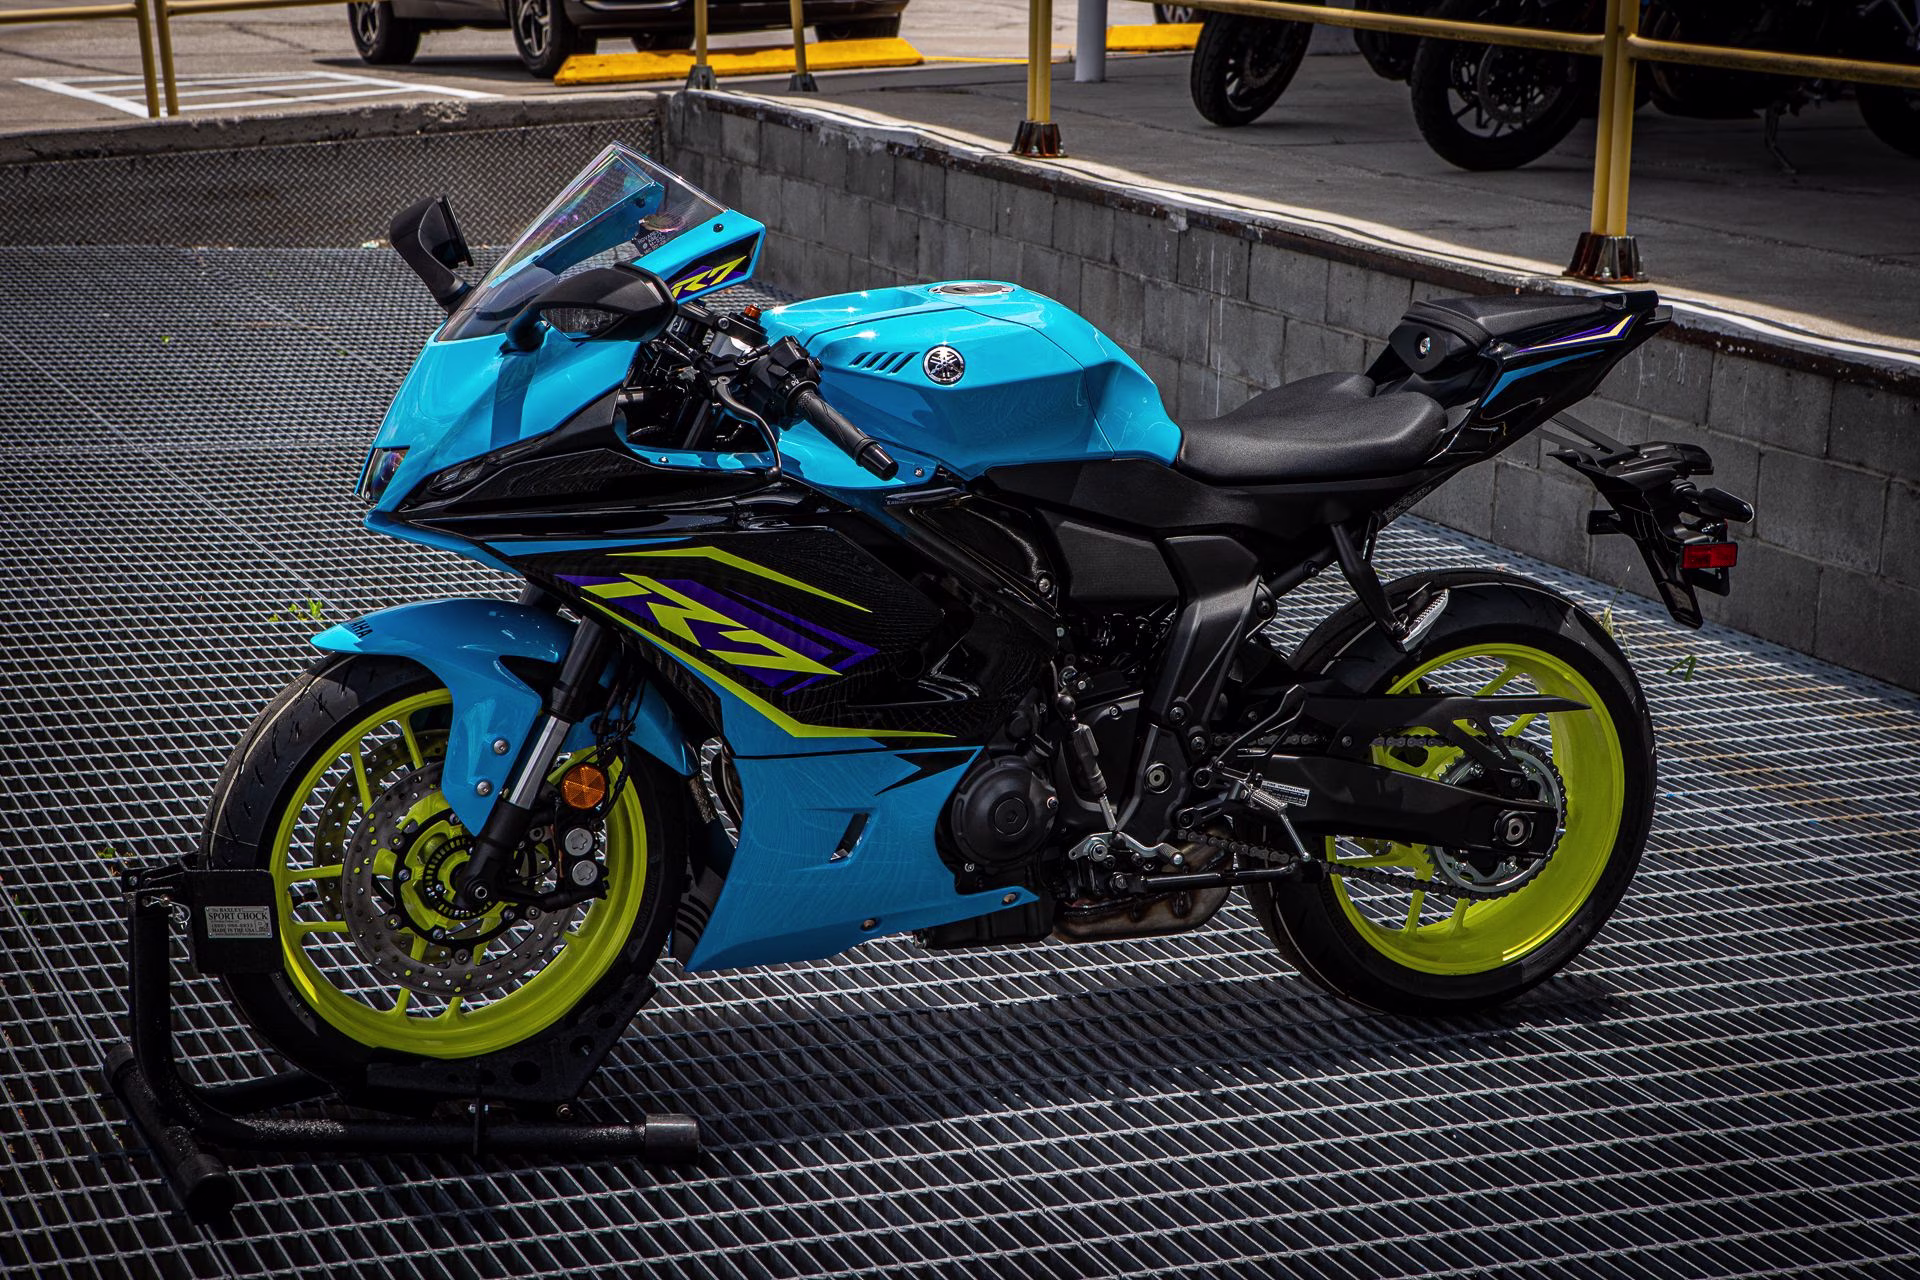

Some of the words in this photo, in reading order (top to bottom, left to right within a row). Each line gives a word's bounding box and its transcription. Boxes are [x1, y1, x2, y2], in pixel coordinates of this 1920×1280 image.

[671, 255, 747, 298] R7
[580, 573, 843, 676] R7
[208, 912, 236, 920] SPORT
[237, 912, 268, 920] CHOCK
